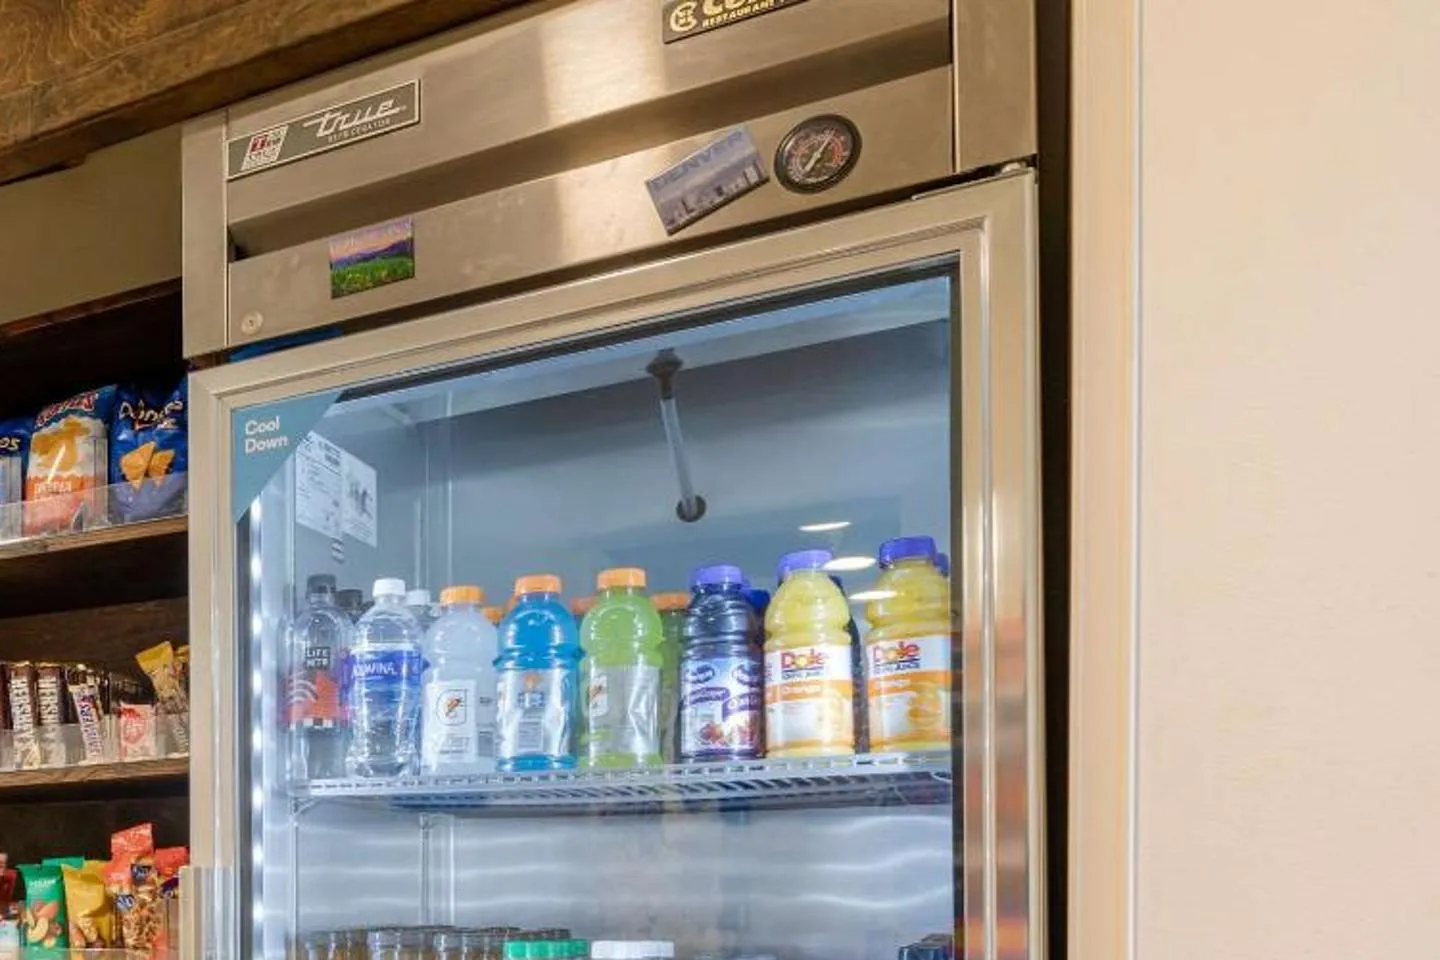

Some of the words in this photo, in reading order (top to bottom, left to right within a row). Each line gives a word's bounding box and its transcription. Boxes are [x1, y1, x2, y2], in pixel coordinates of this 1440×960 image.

[245, 416, 280, 435] Cool
[245, 436, 289, 454] Down
[781, 649, 826, 669] Dole
[873, 641, 920, 662] Dole
